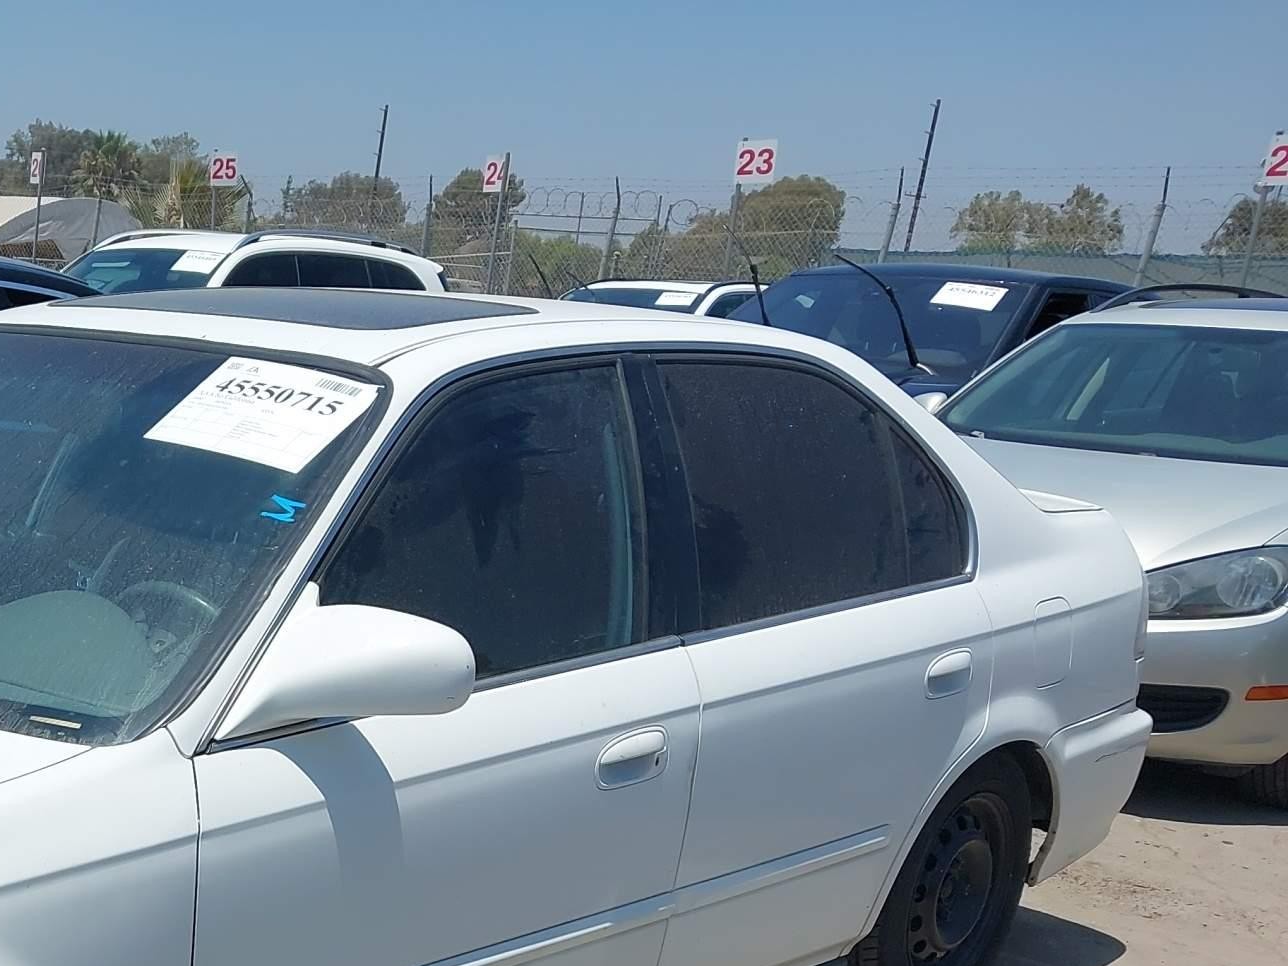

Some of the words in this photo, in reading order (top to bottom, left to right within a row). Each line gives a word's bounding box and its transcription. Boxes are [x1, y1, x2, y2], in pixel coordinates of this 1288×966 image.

[212, 158, 236, 179] 25
[737, 149, 774, 175] 23
[216, 378, 344, 416] 45550715
